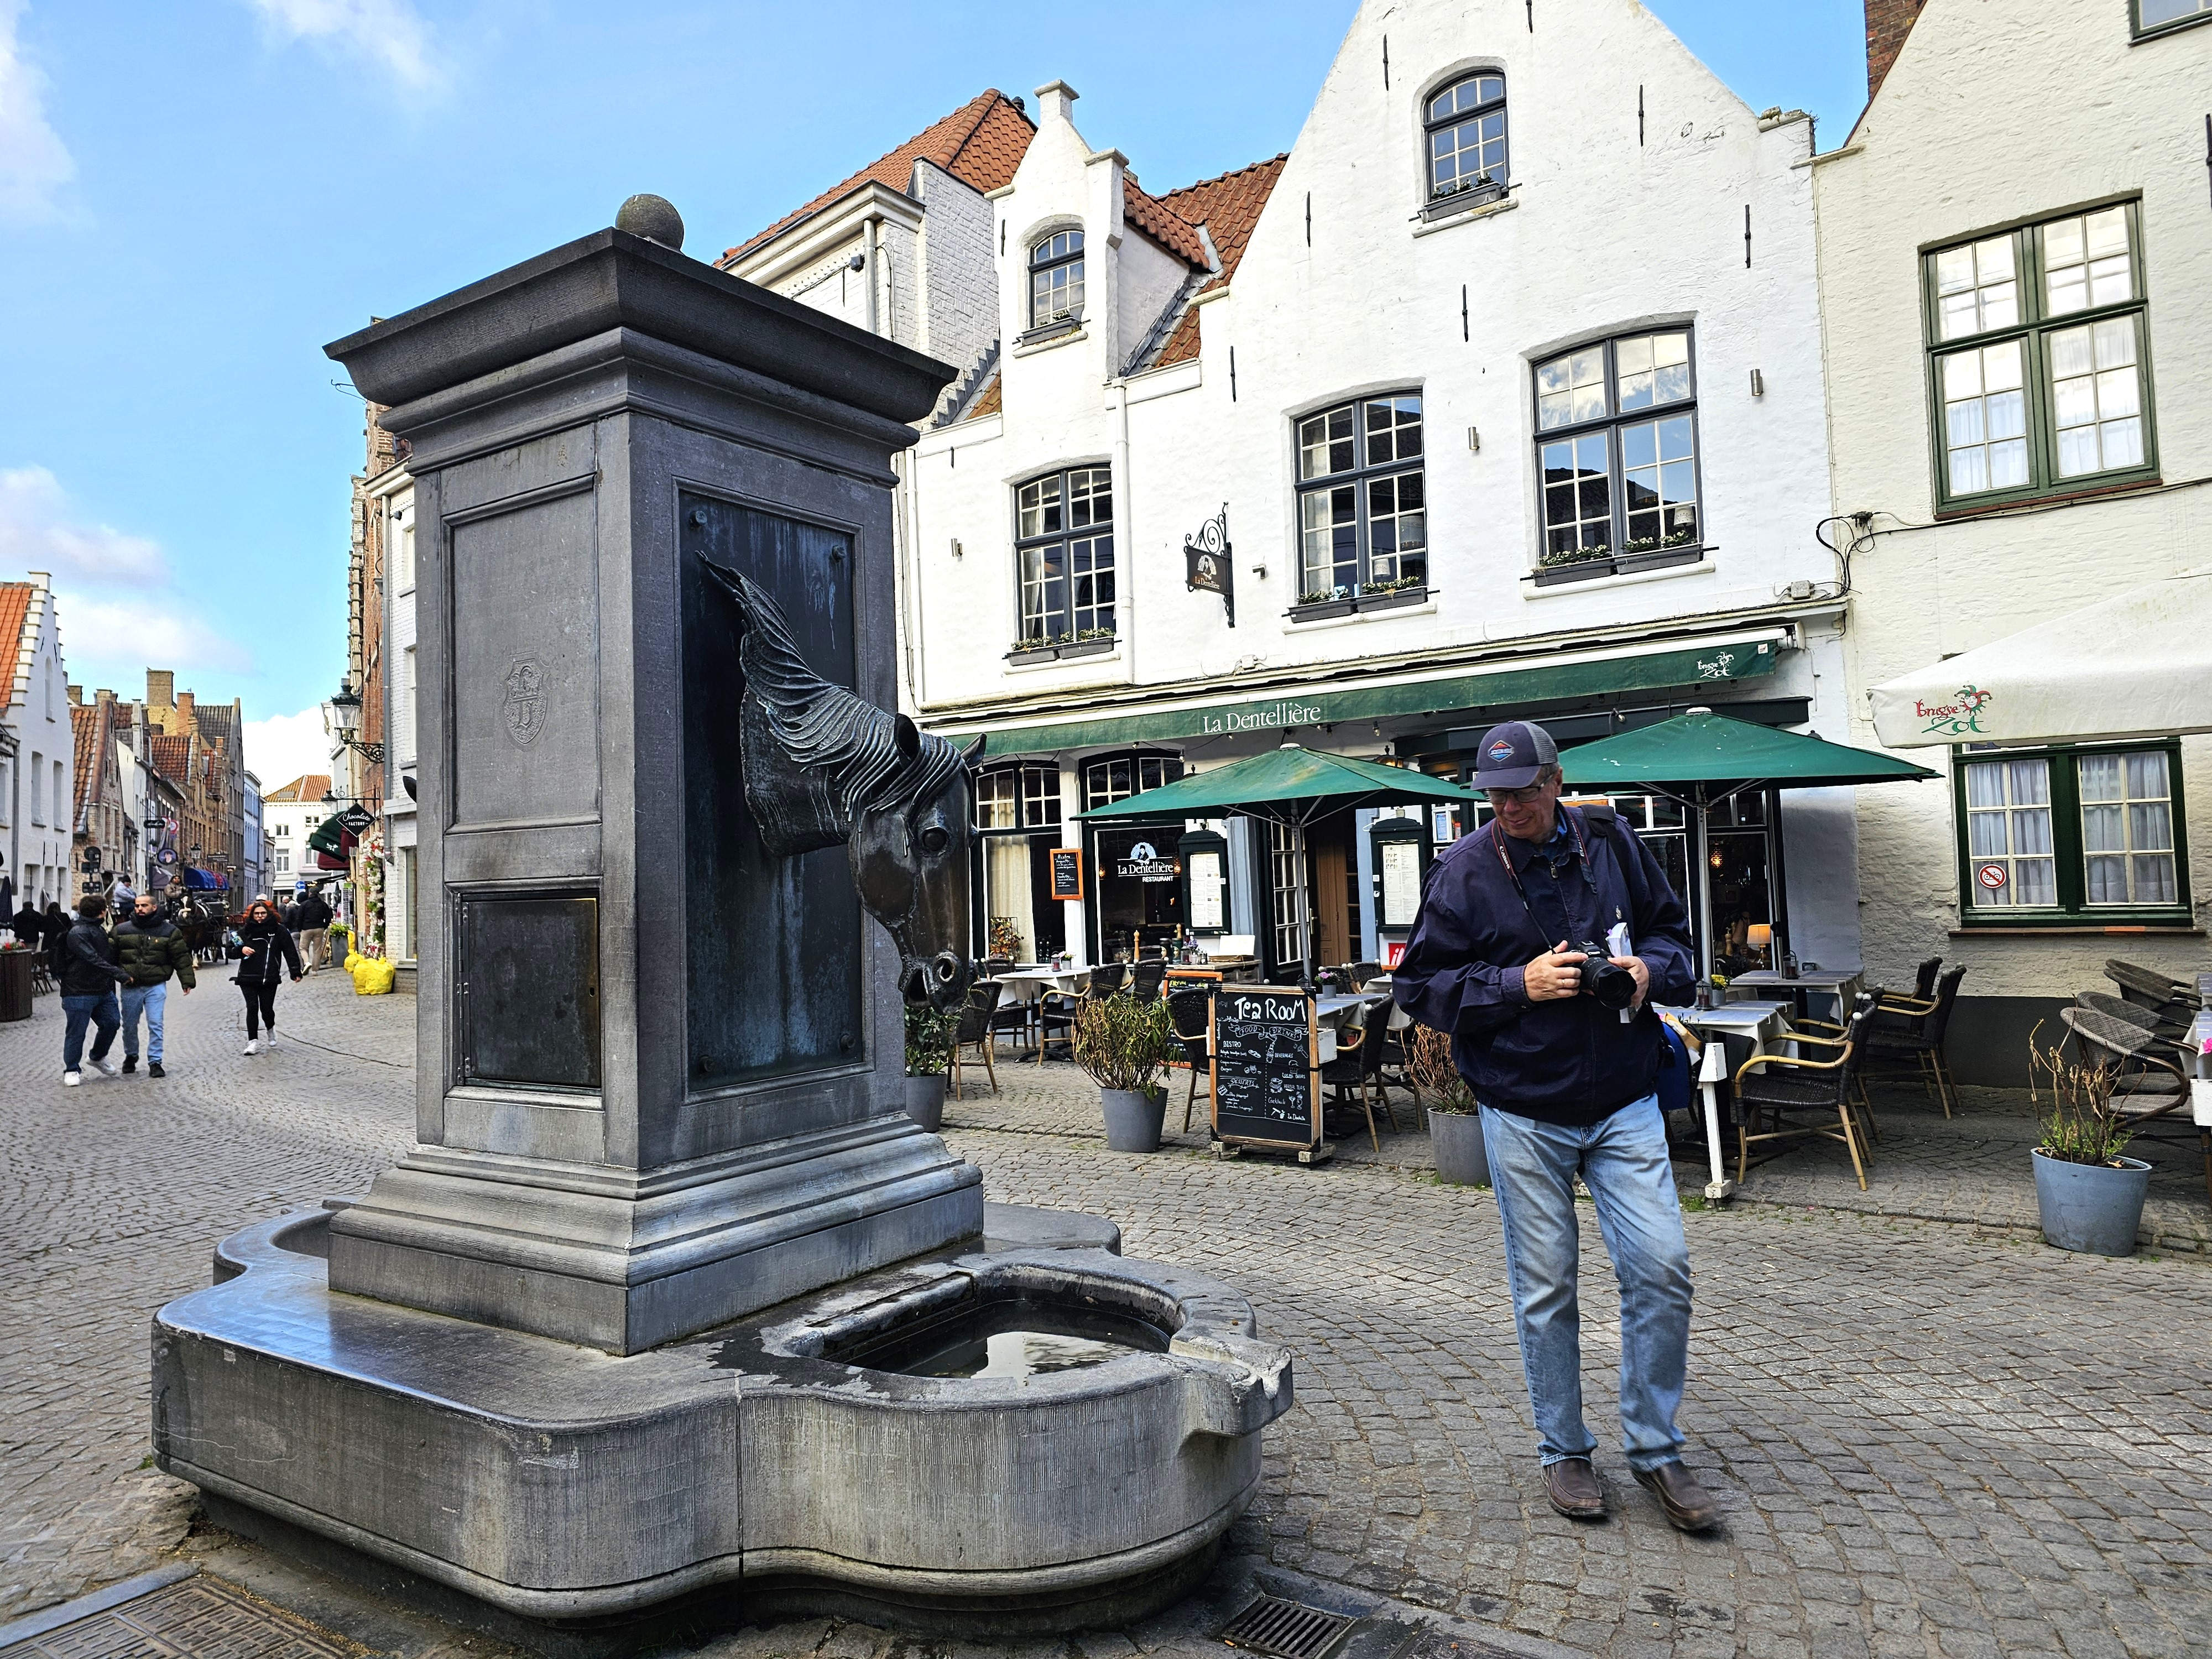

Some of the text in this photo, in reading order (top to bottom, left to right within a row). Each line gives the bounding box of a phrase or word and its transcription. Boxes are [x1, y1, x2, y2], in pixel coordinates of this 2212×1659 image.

[1700, 667, 1733, 679] Zot
[1203, 702, 1321, 734] La Dentellière
[1921, 716, 1991, 736] Zot
[343, 813, 371, 822] Chocolate
[1117, 861, 1173, 874] La Dentellière
